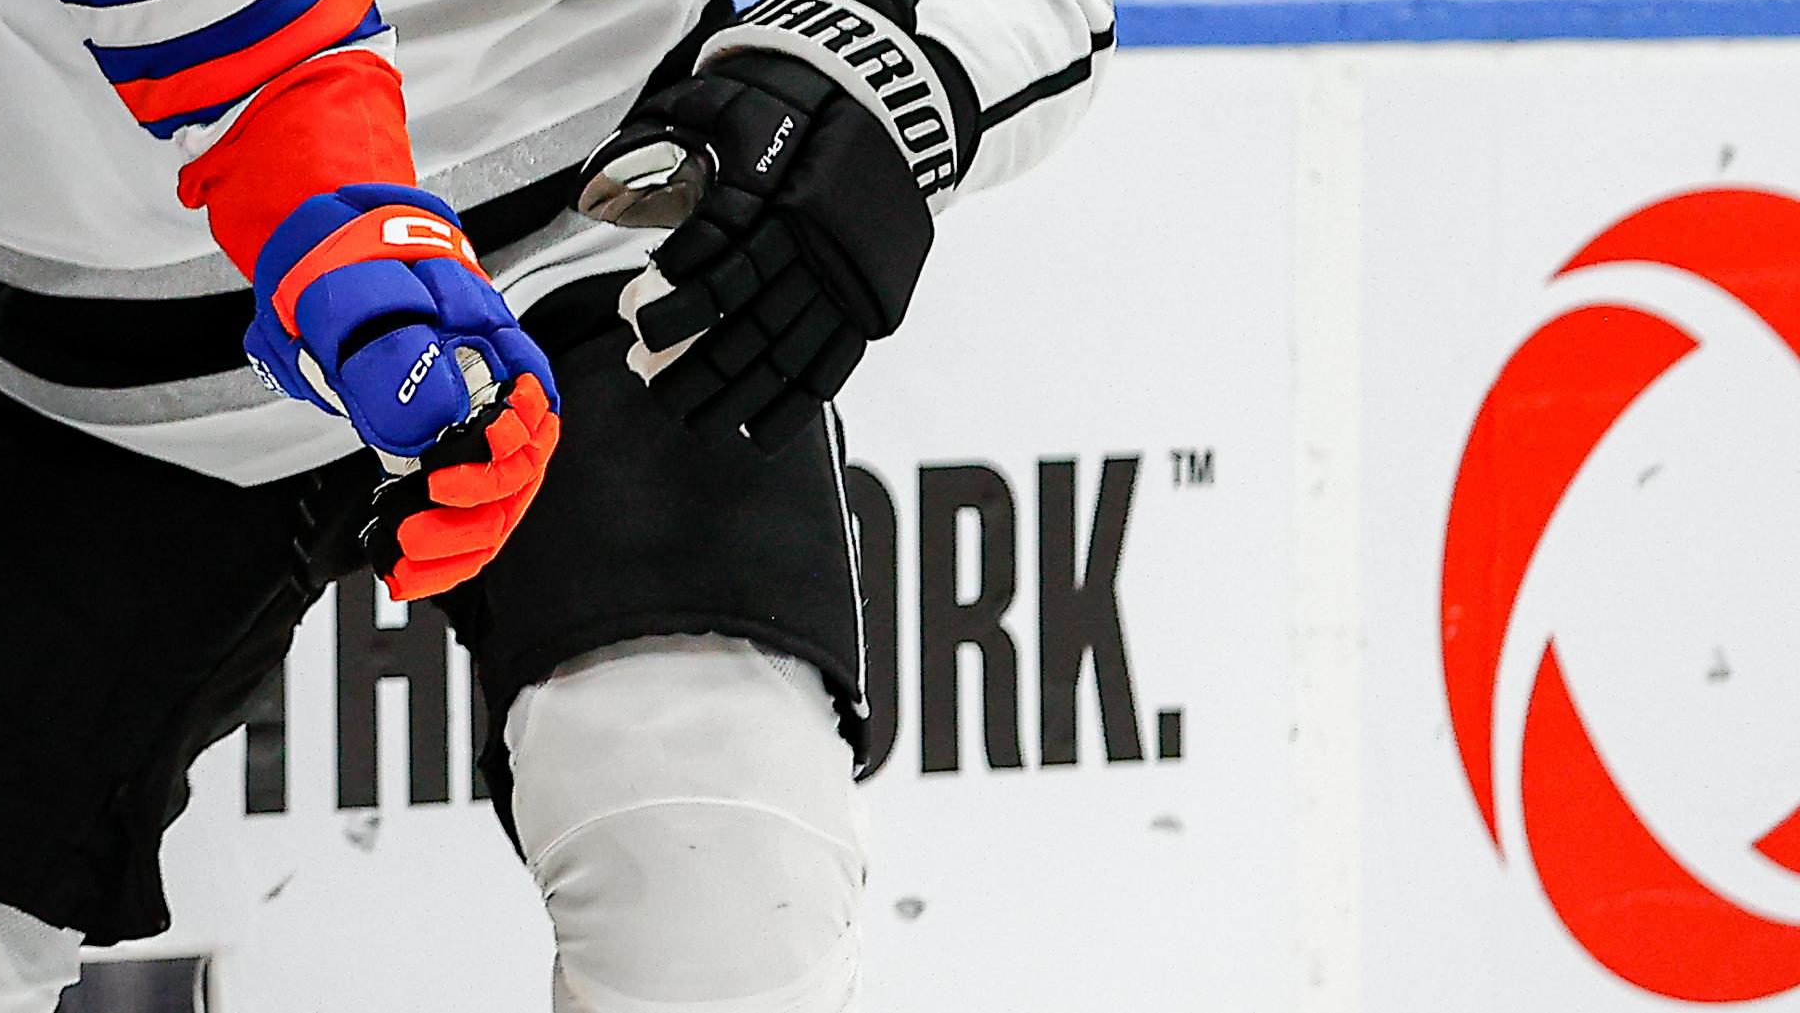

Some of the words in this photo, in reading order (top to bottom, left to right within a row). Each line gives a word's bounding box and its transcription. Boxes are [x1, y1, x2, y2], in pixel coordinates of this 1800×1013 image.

[756, 115, 795, 174] ALPHA
[398, 342, 440, 405] CCM
[845, 456, 1182, 783] ORK.
[1170, 451, 1213, 485] TM
